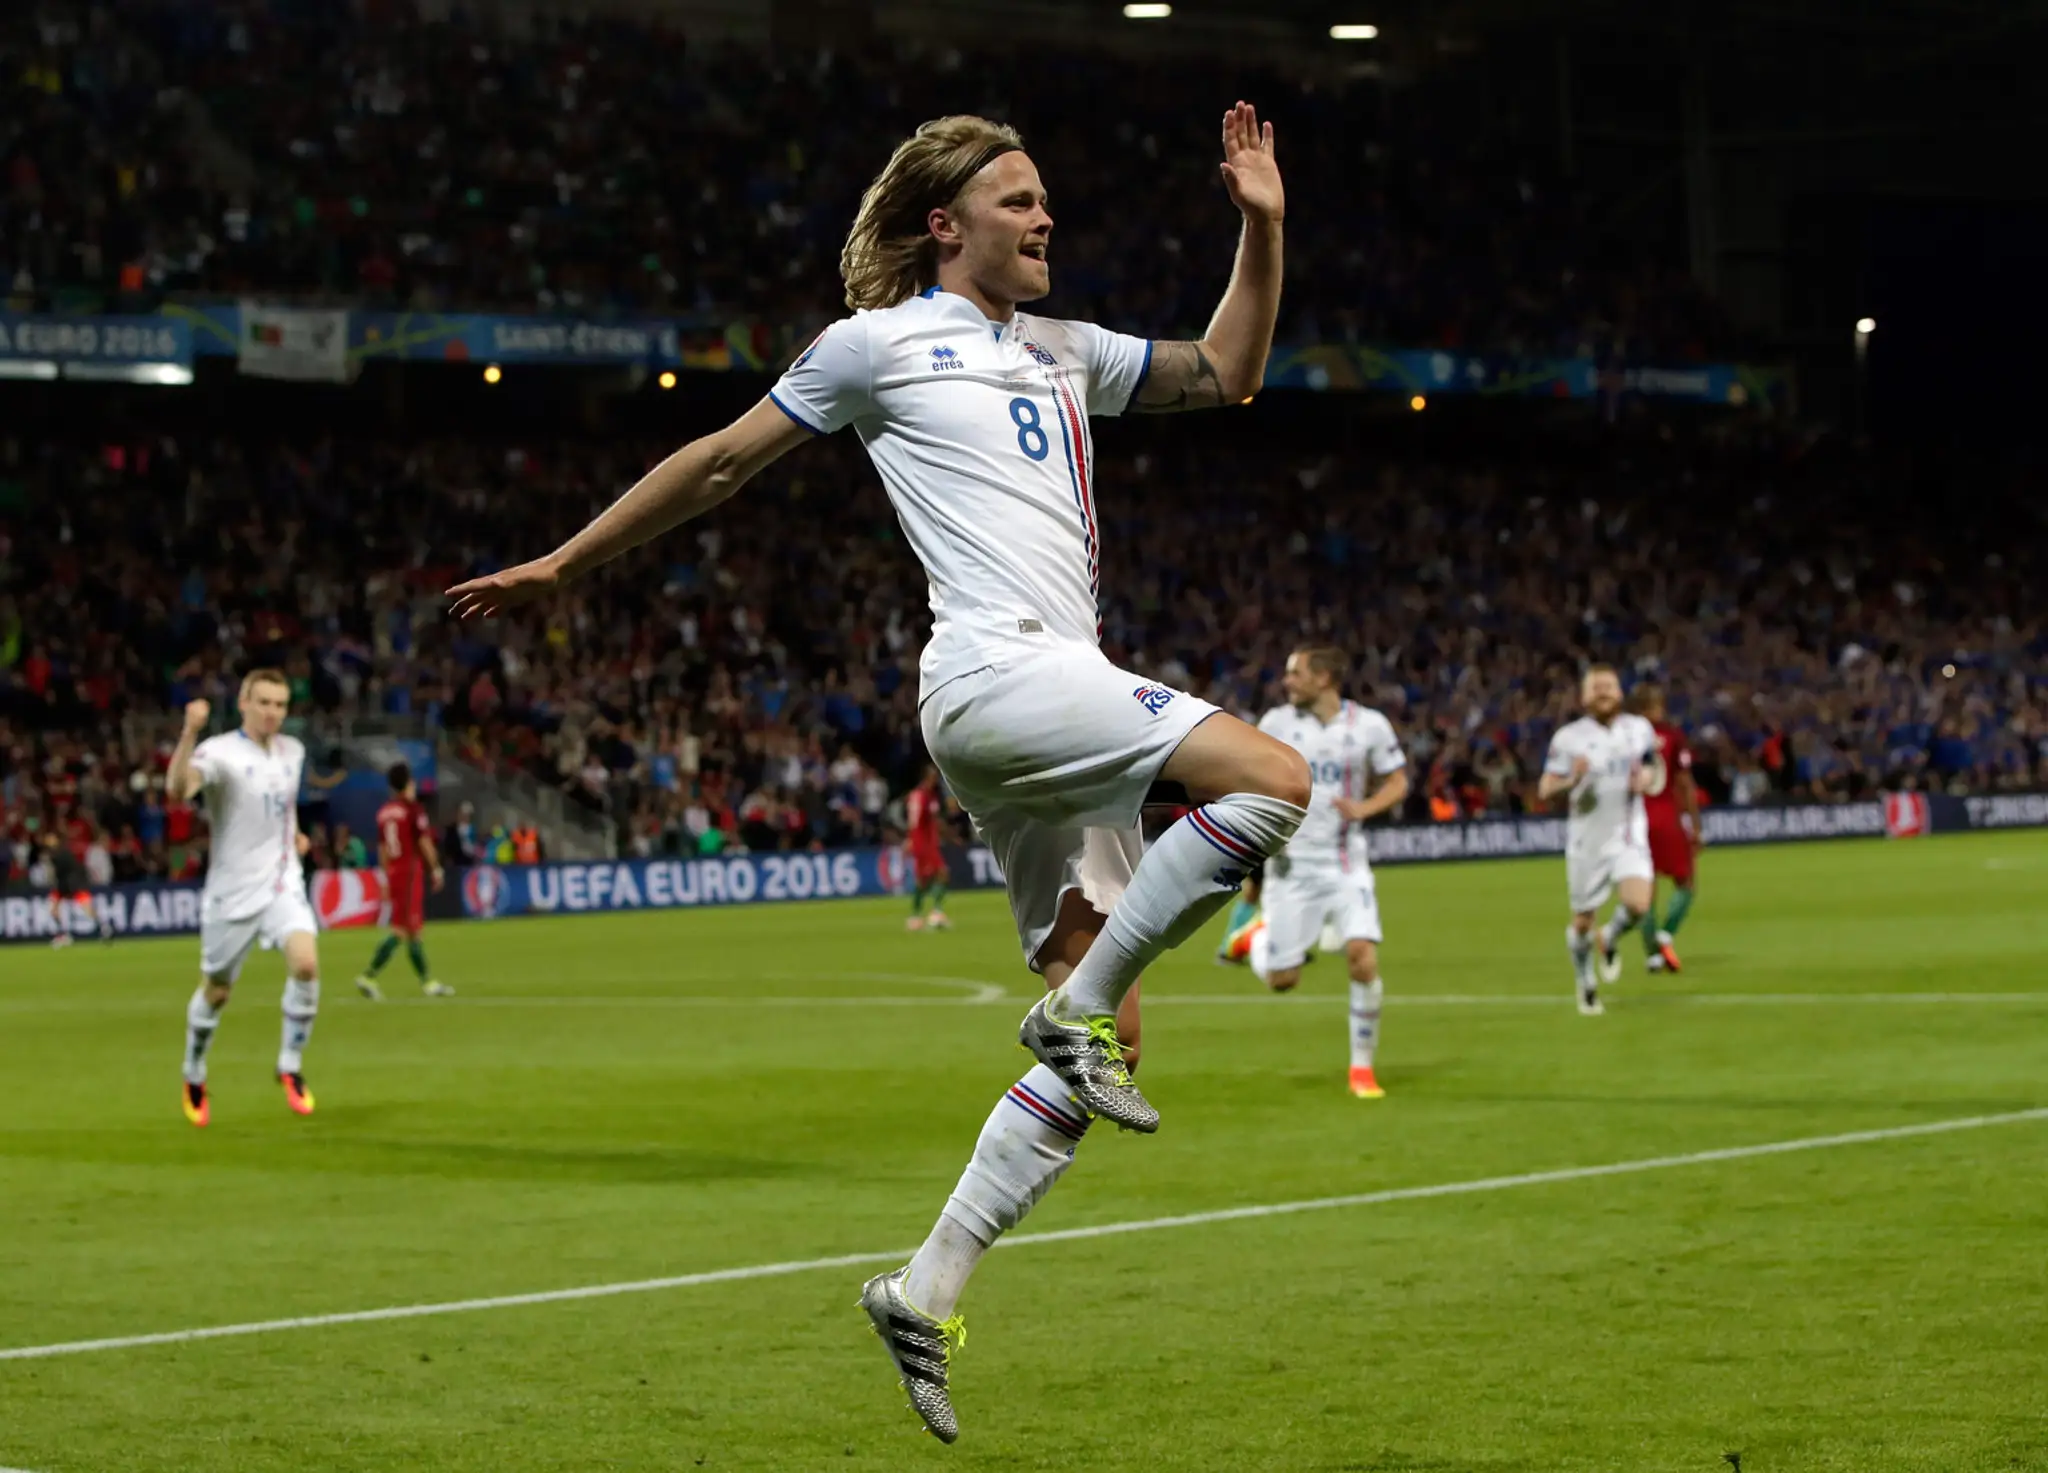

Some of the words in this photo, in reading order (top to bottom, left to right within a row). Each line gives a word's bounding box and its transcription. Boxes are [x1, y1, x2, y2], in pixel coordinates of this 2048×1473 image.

[15, 321, 98, 355] EURO
[103, 324, 178, 357] 2016
[1009, 397, 1048, 461] 8
[1310, 760, 1340, 785] 10
[527, 862, 641, 909] UEFA
[645, 858, 757, 906] EURO
[762, 853, 861, 899] 2016
[130, 888, 202, 931] AIR
